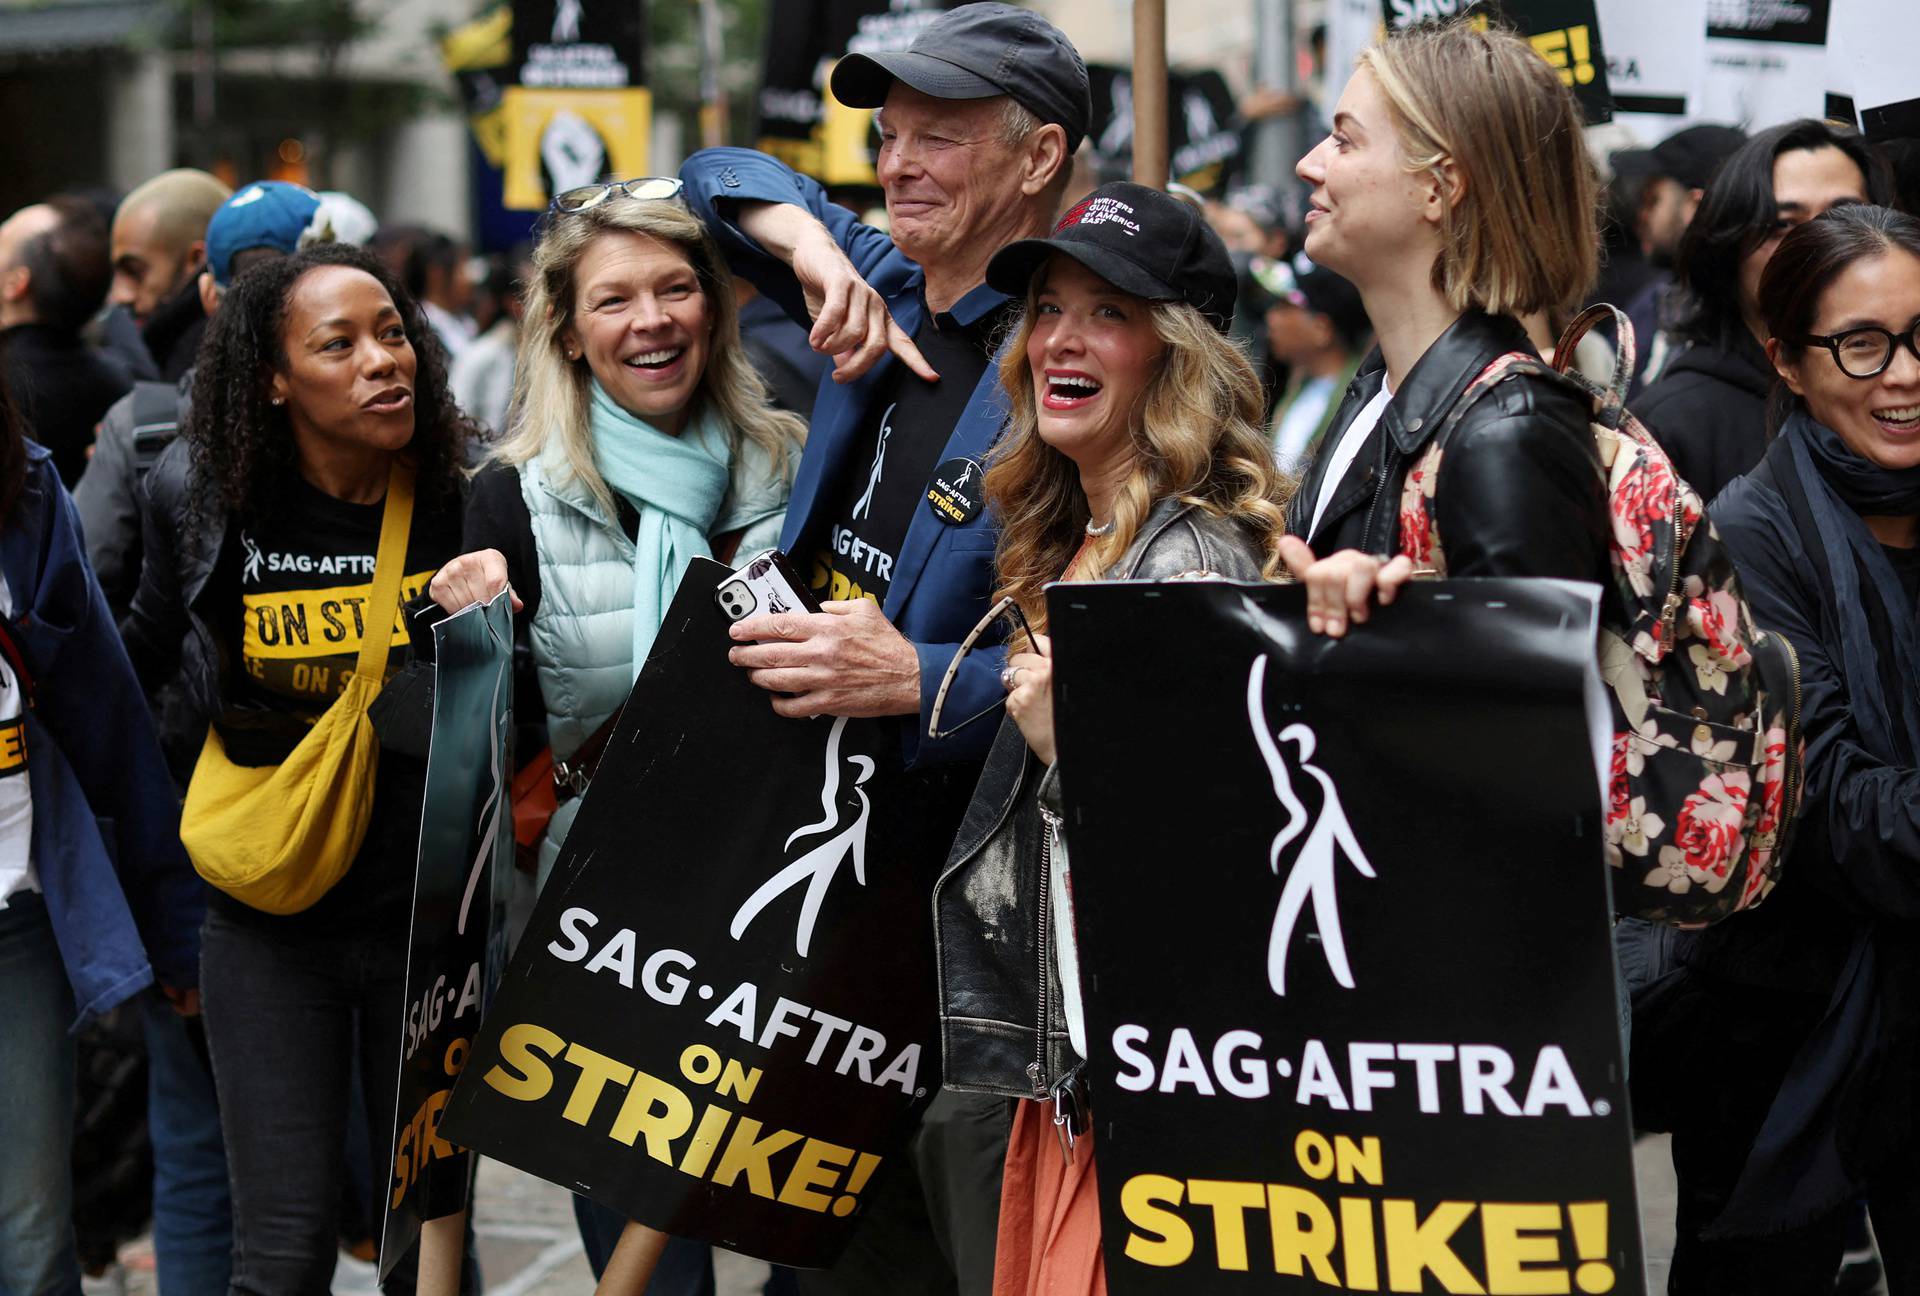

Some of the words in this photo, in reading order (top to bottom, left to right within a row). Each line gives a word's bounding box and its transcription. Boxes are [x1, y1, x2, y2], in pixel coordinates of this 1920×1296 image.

[1080, 217, 1107, 225] EAST
[1084, 210, 1096, 218] of
[1095, 211, 1141, 232] AMERICA
[1088, 204, 1118, 214] GUILD
[1093, 197, 1134, 214] WRITERS
[927, 489, 966, 522] STRIKE!
[268, 552, 377, 575] SAG·AFTR
[256, 603, 310, 646] ON
[292, 663, 330, 694] ON
[678, 1043, 764, 1104] ON
[482, 1023, 883, 1218] STRIKE!
[1294, 1128, 1384, 1186] ON
[1119, 1173, 1616, 1296] STRIKE!
